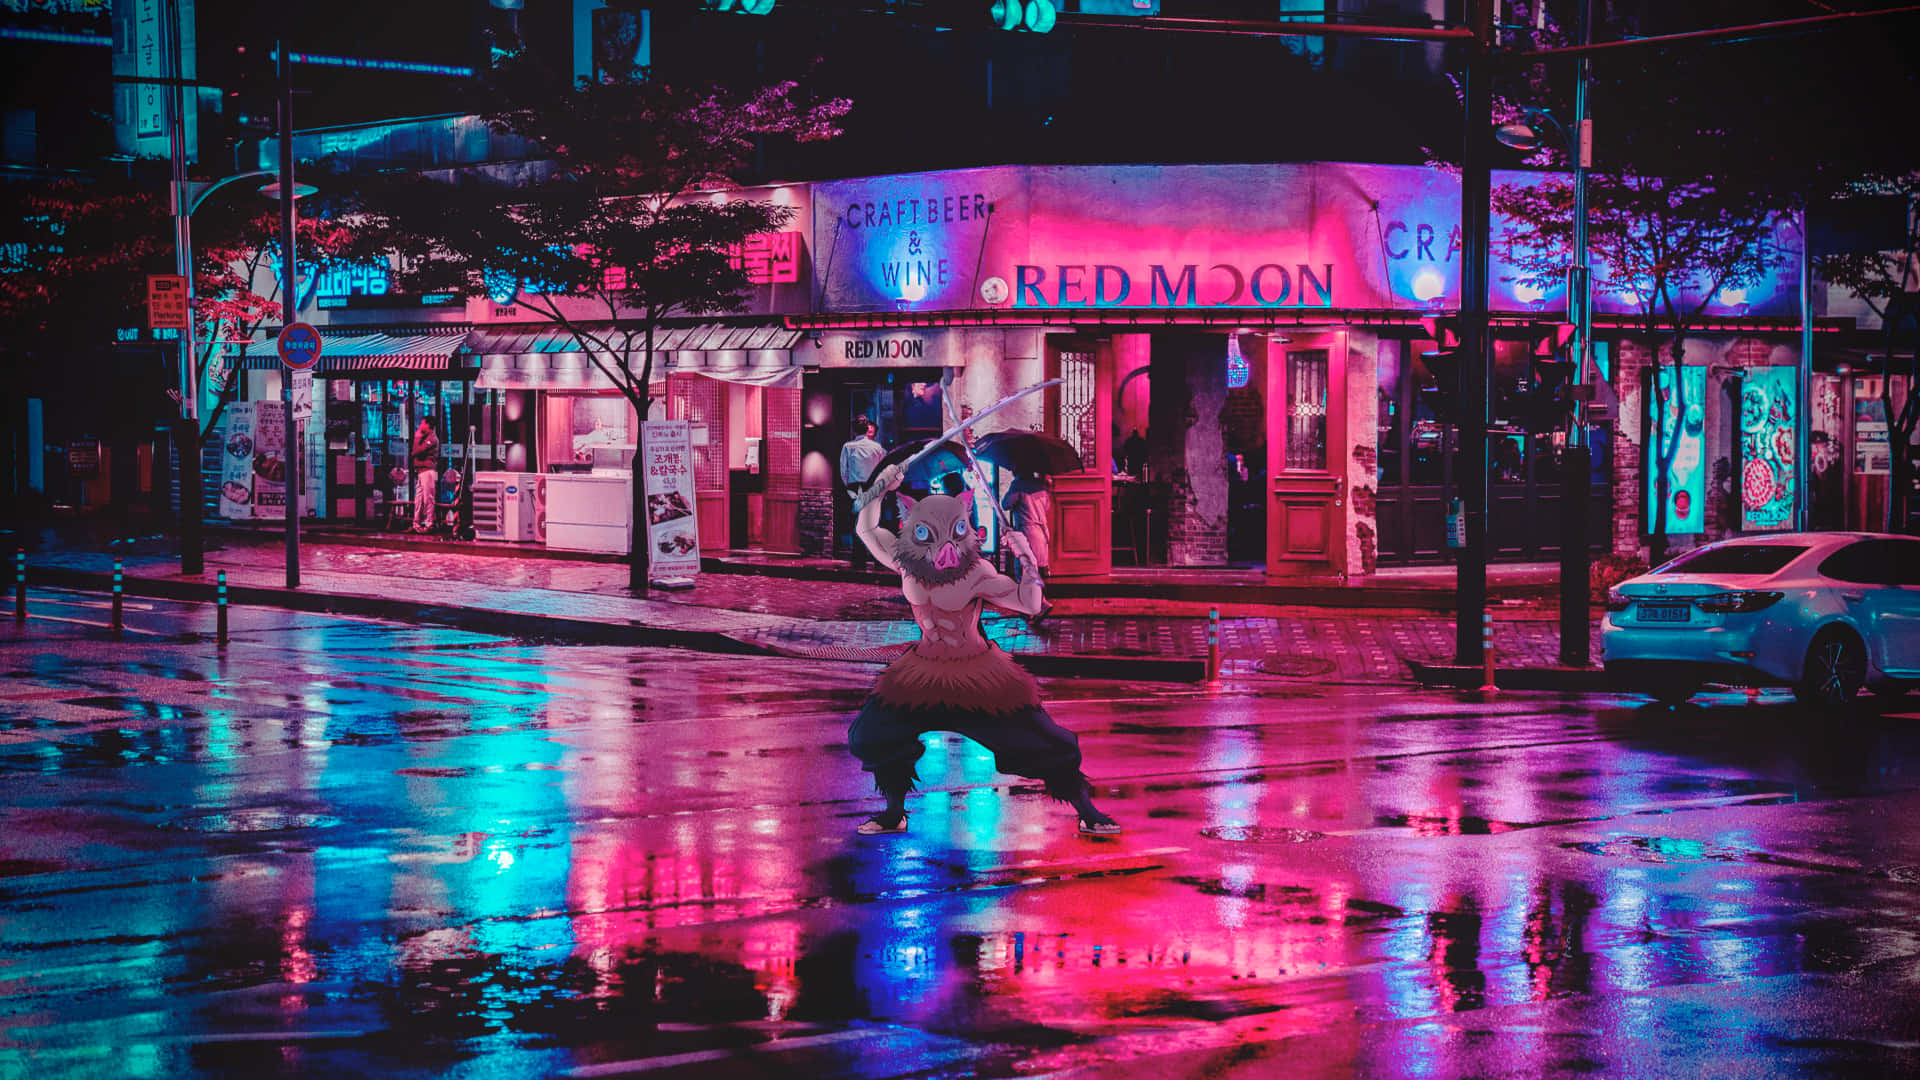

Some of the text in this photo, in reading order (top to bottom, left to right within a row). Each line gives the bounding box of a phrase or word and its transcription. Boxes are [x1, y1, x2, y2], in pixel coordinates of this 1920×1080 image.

[846, 194, 985, 229] CRAFT BEER
[908, 230, 922, 256] &
[881, 259, 949, 288] WINE
[1012, 264, 1131, 308] RED
[844, 340, 873, 358] RED
